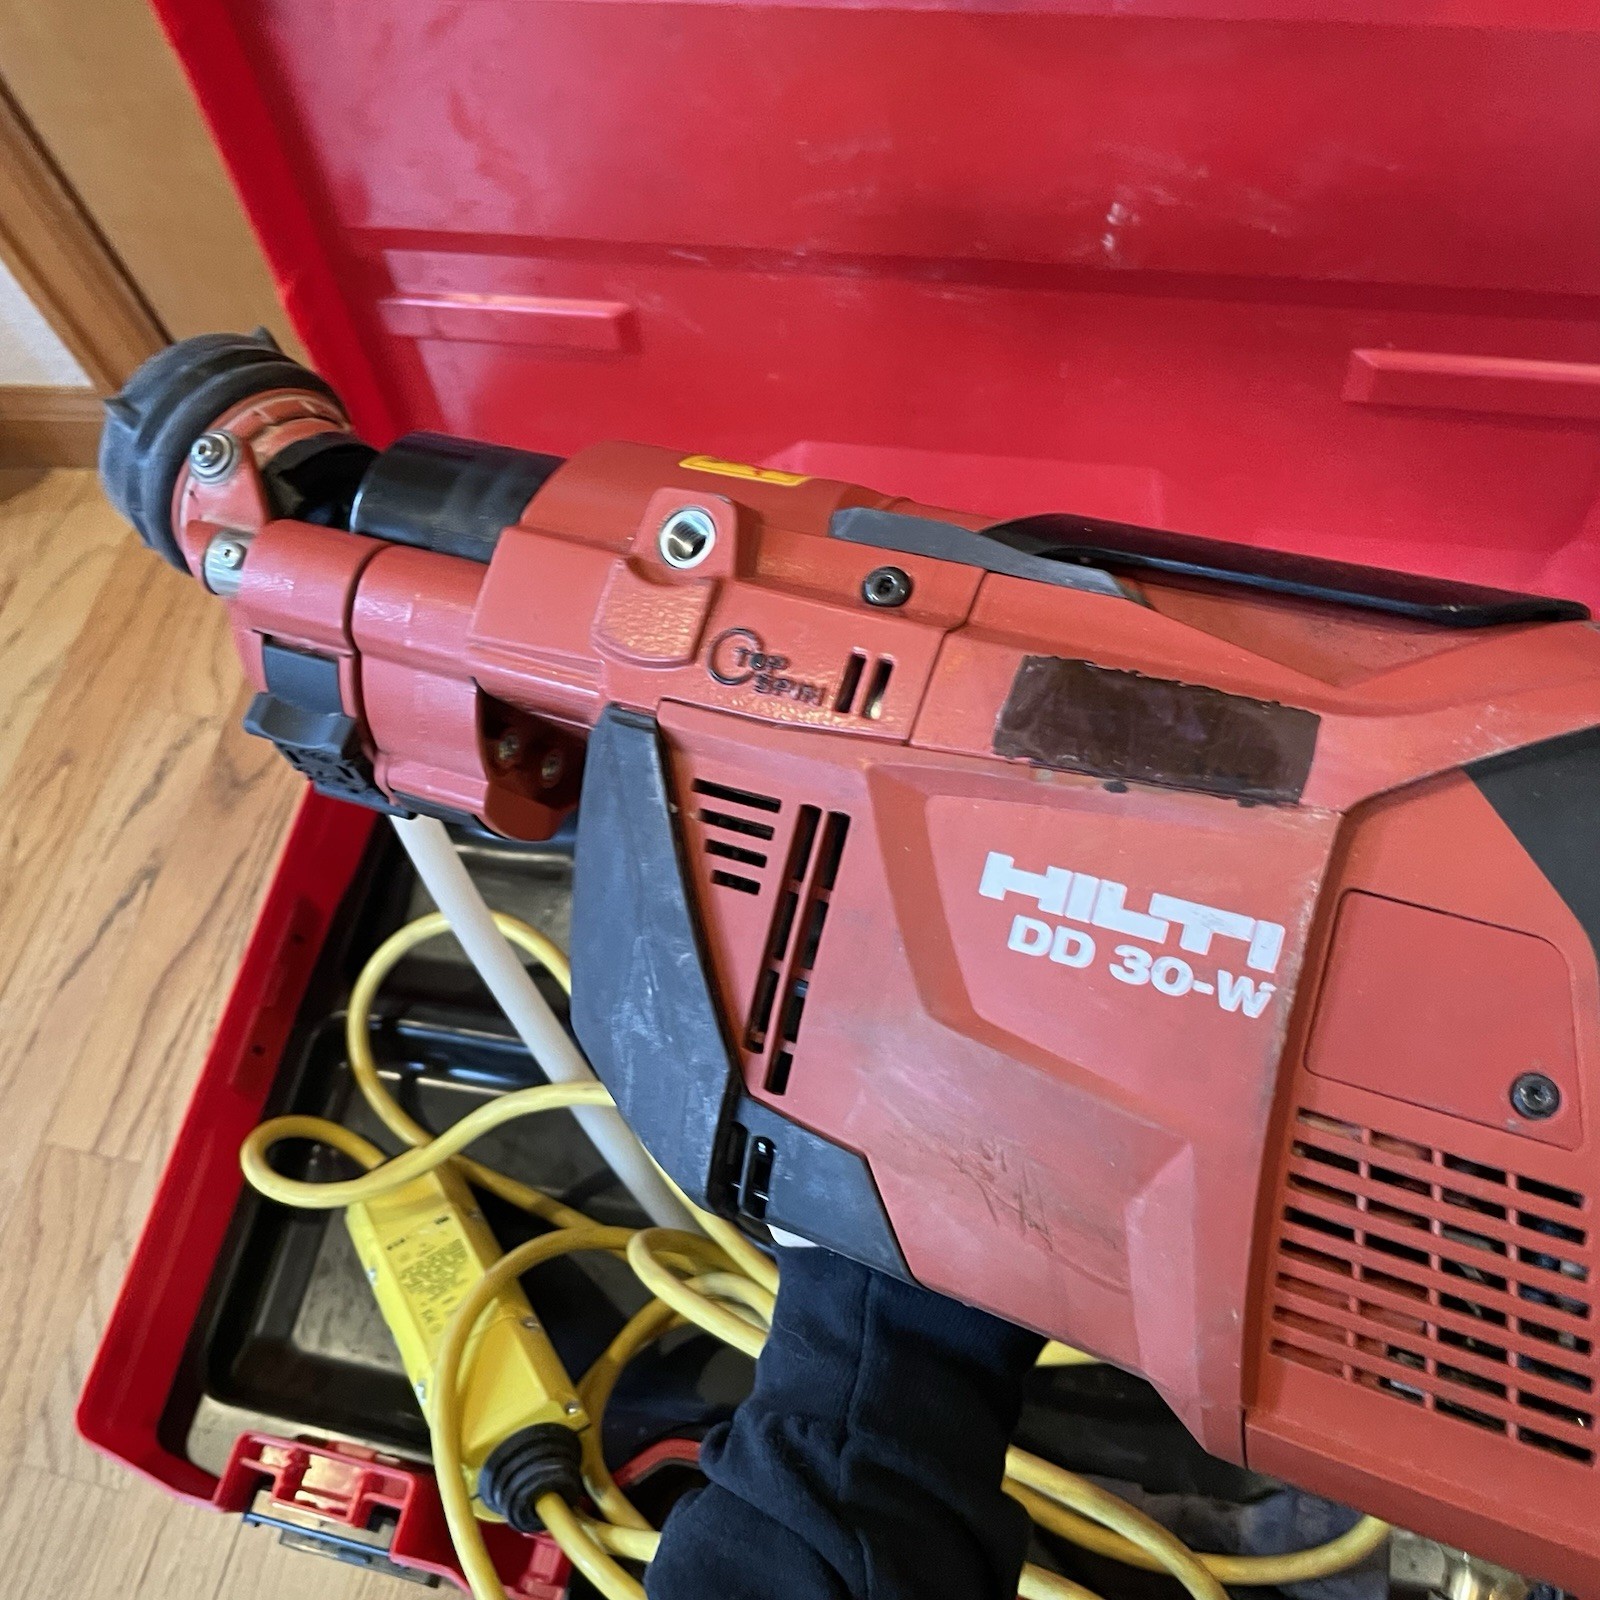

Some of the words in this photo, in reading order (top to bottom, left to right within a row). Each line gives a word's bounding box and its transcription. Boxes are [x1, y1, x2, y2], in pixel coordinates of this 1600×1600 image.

[979, 851, 1285, 973] HILTI
[1007, 914, 1096, 968] DD
[1109, 944, 1277, 1019] 30-W
